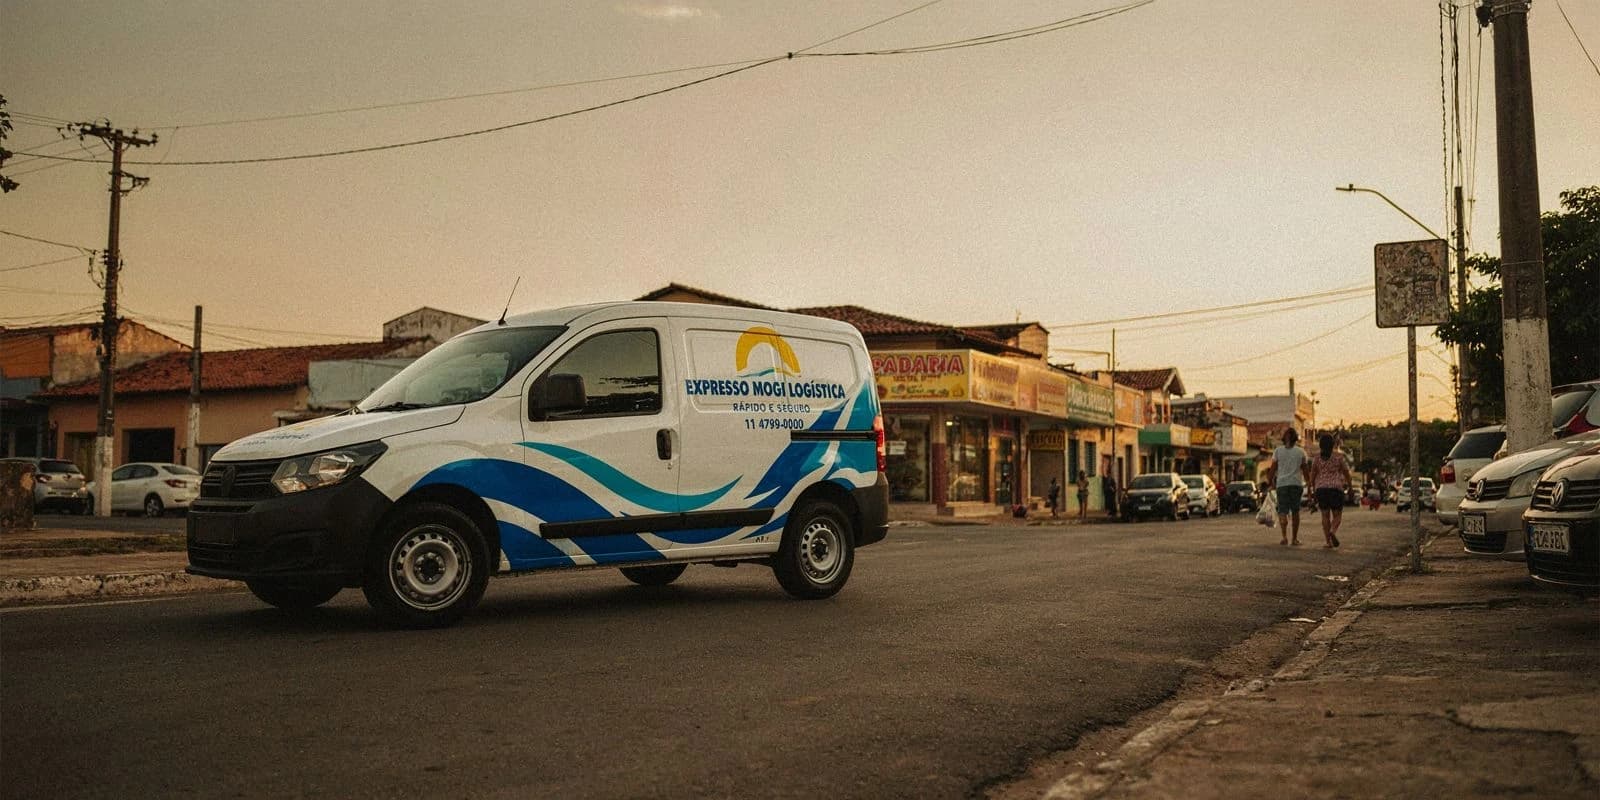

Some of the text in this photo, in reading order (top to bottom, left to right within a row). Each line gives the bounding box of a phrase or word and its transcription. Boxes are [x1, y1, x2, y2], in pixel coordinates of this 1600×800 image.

[872, 354, 963, 375] PADARIA
[685, 379, 845, 398] EXPRESSO MOGI LOGÍSTICA
[732, 401, 766, 412] RÁPIDO
[768, 403, 774, 413] E
[745, 418, 804, 430] 11 4799-0000
